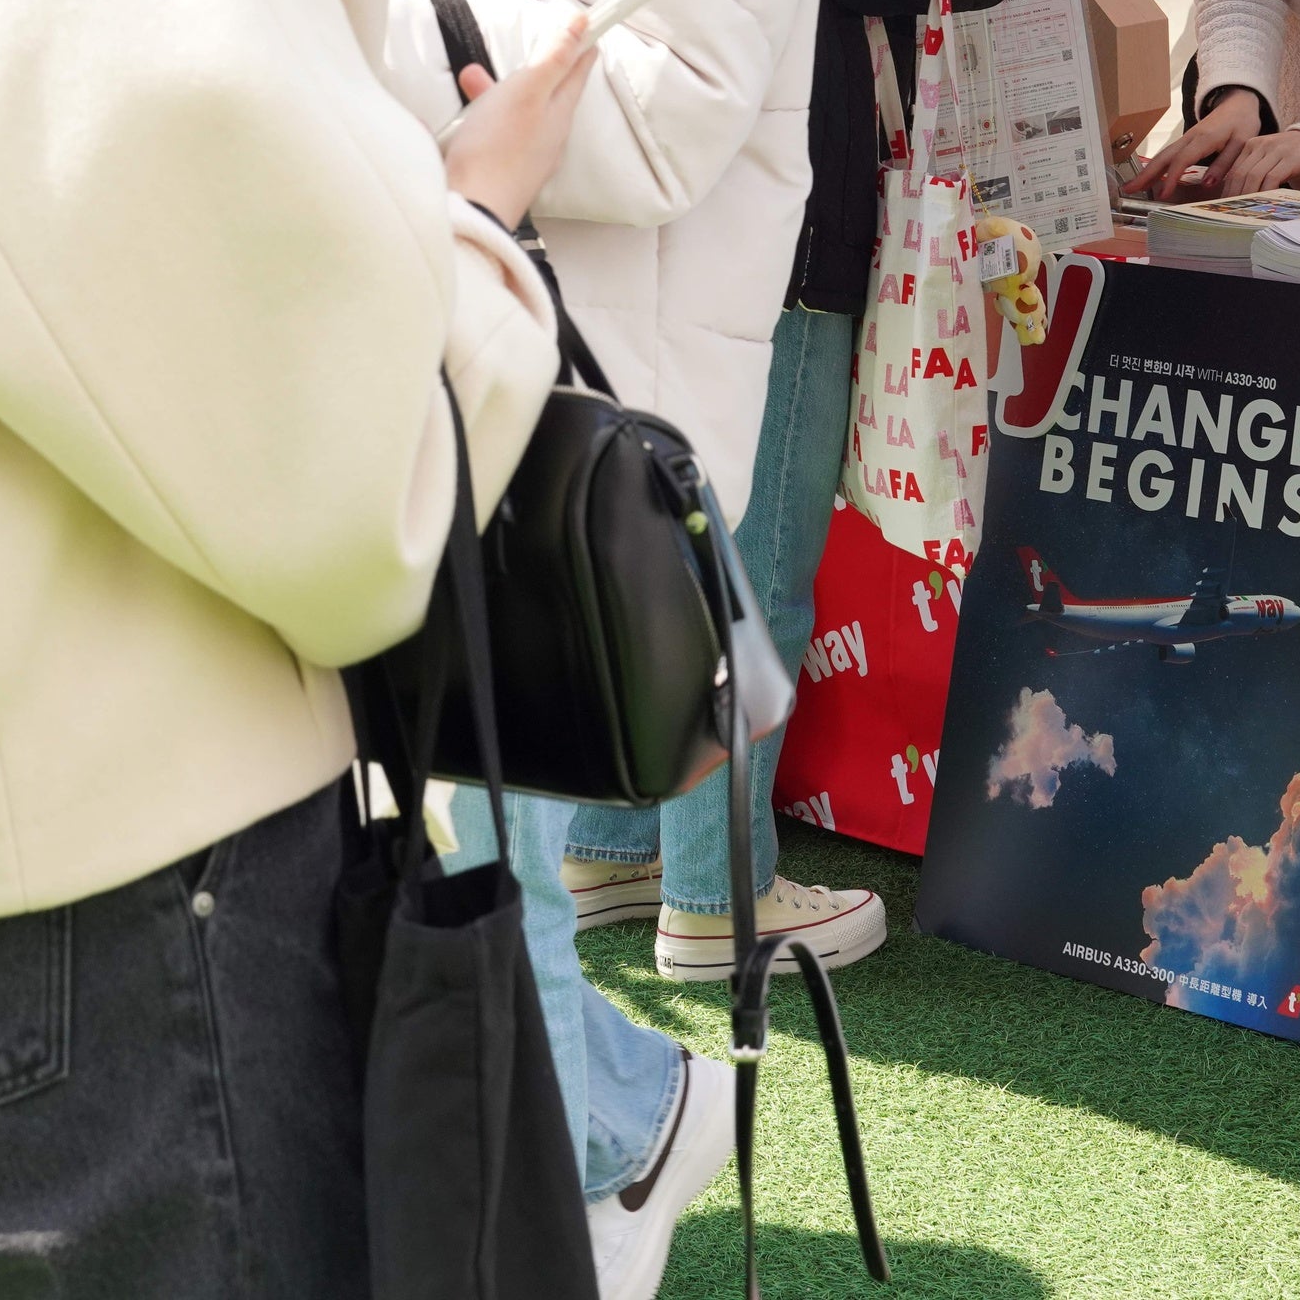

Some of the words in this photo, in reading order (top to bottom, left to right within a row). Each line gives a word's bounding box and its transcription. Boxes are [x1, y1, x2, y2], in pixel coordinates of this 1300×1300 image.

[1109, 353, 1120, 368] 더
[1121, 356, 1142, 372] 멋진
[1143, 358, 1173, 376] 변화의
[1174, 363, 1196, 380] 시작
[1196, 367, 1224, 383] WITH
[1224, 371, 1278, 391] A330-300
[1062, 941, 1112, 967] AIRBUS
[1113, 955, 1176, 984] A330-300
[1178, 973, 1243, 1003] 中長距離型機
[1246, 991, 1268, 1010] 導入
